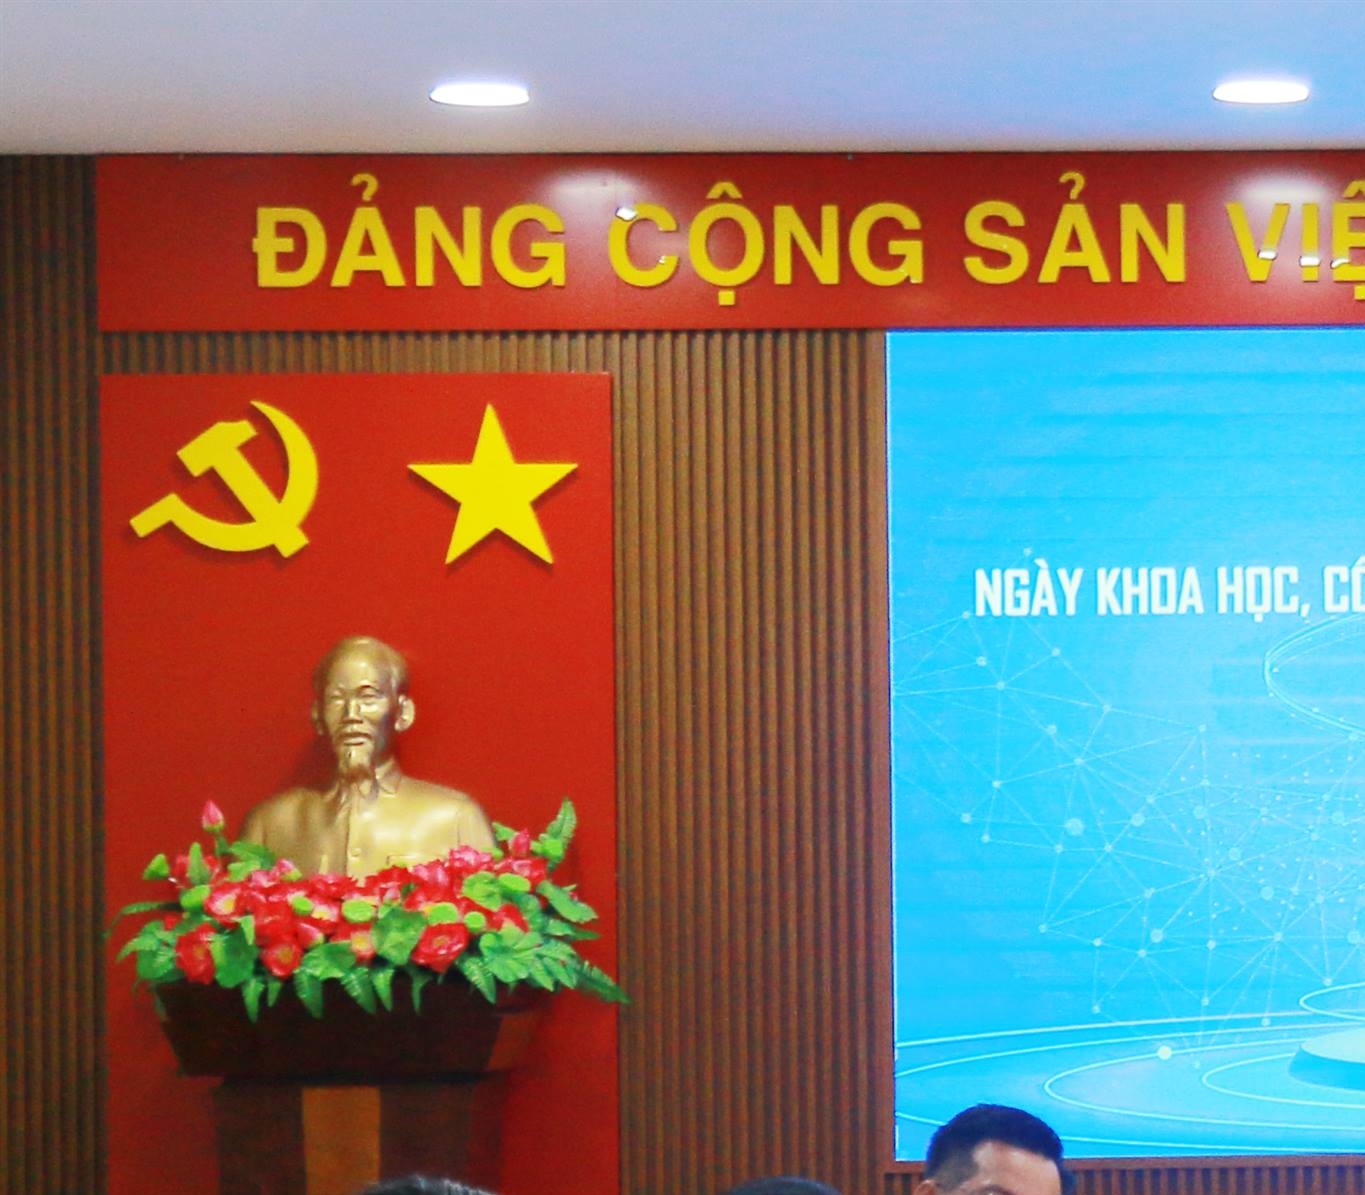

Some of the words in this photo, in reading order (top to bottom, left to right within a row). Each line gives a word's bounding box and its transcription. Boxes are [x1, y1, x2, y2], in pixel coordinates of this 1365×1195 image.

[252, 173, 566, 287] ĐẢNG
[607, 181, 923, 304] CỘNG
[964, 171, 1185, 283] SẢN
[975, 558, 1083, 616] NGÀY
[1097, 567, 1204, 615] KHOA
[1218, 566, 1309, 622] HỌC,
